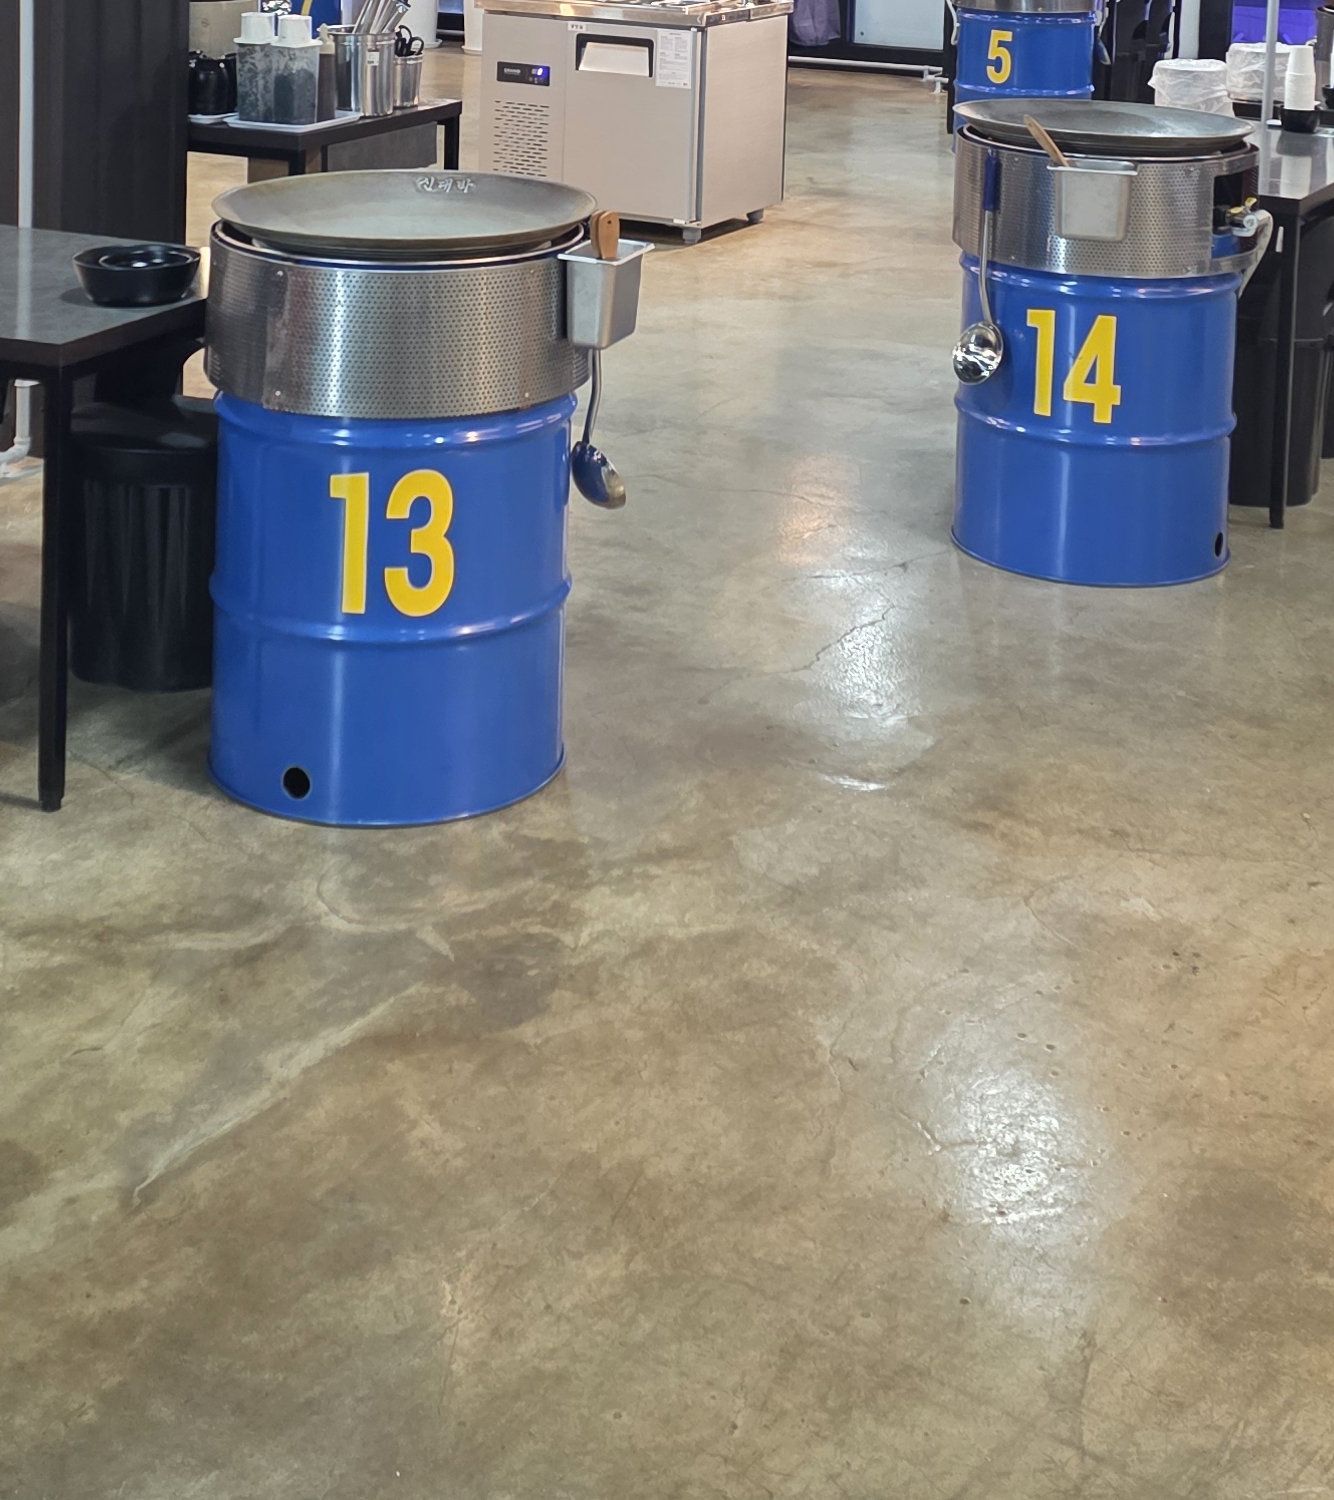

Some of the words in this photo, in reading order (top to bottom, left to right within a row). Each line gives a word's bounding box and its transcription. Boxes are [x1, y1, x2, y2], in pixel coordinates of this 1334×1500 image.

[985, 30, 1013, 84] 5
[1025, 308, 1121, 424] 14
[329, 468, 455, 617] 13
